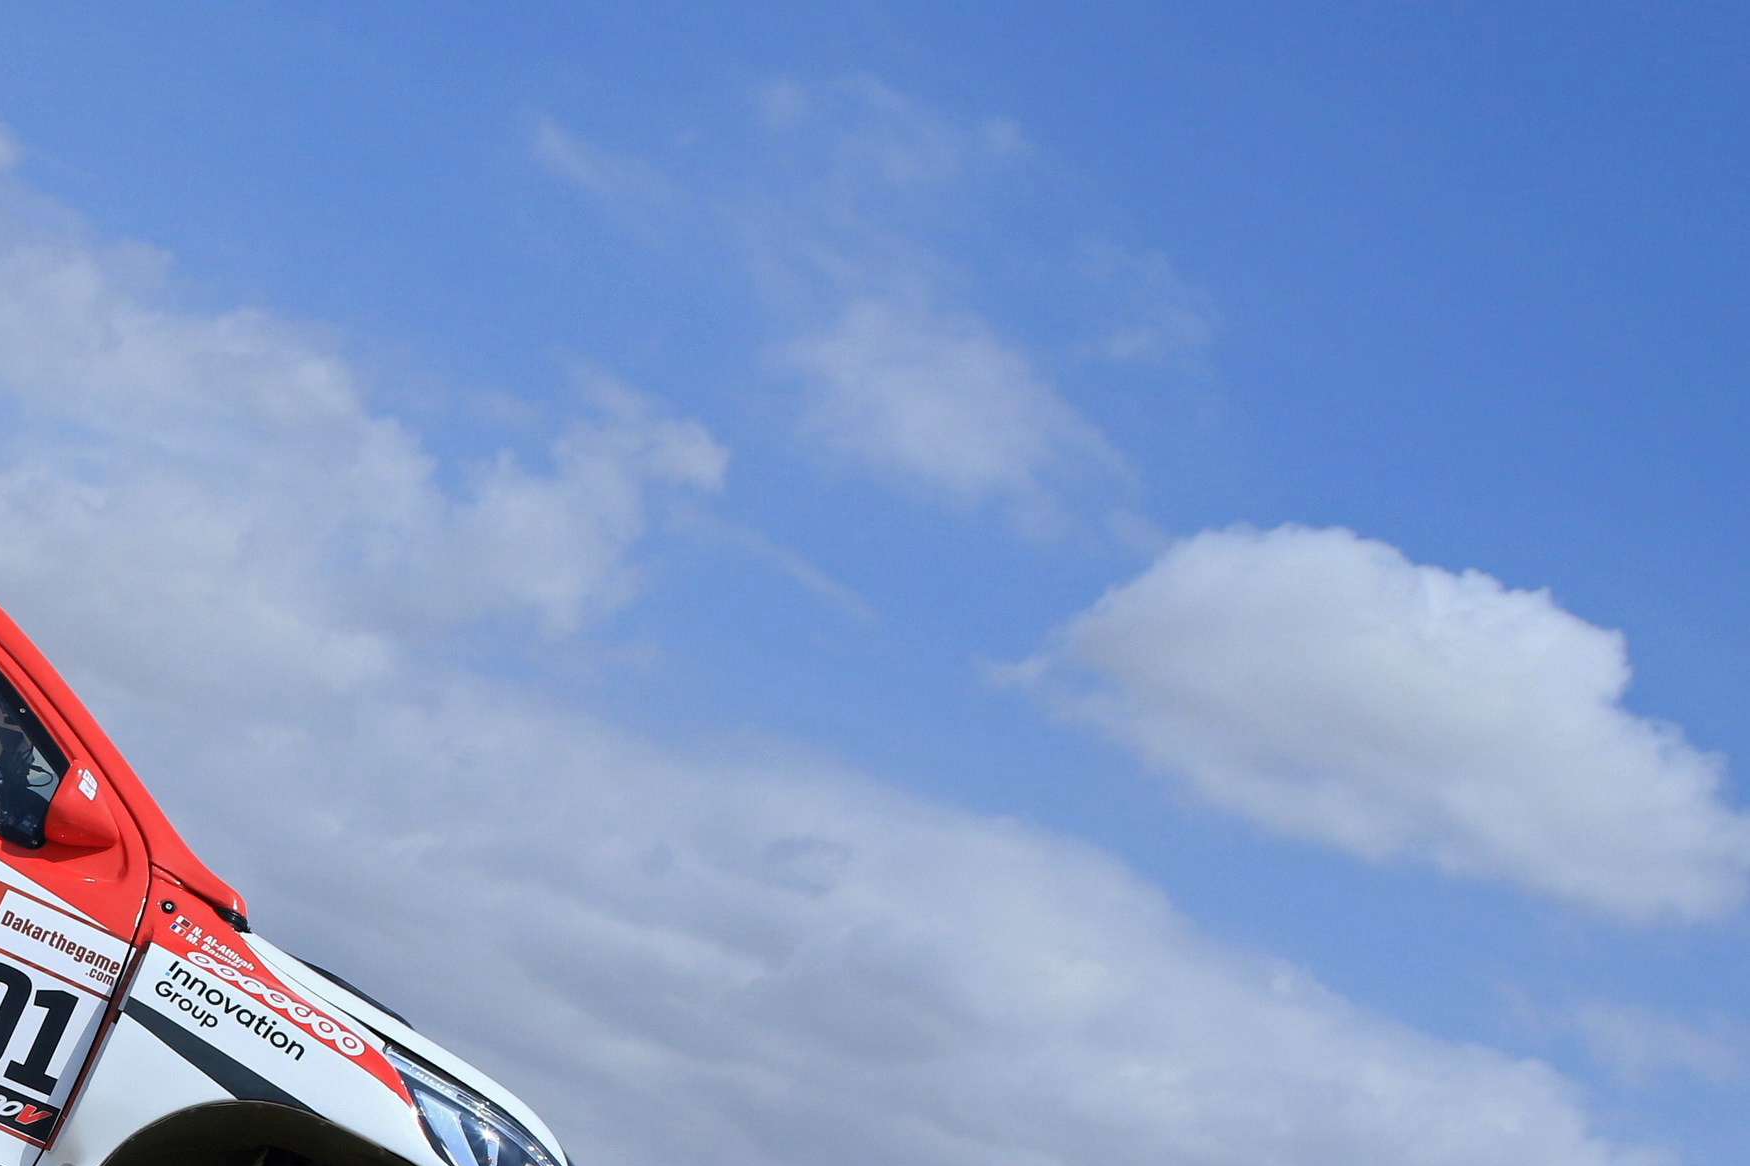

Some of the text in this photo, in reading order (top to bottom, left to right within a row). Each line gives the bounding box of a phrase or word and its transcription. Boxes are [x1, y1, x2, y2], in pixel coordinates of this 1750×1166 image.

[1, 909, 122, 976] Dakarthegame
[185, 934, 199, 946] M.
[191, 926, 255, 971] N. Al-Attiyah
[155, 980, 218, 1028] Group
